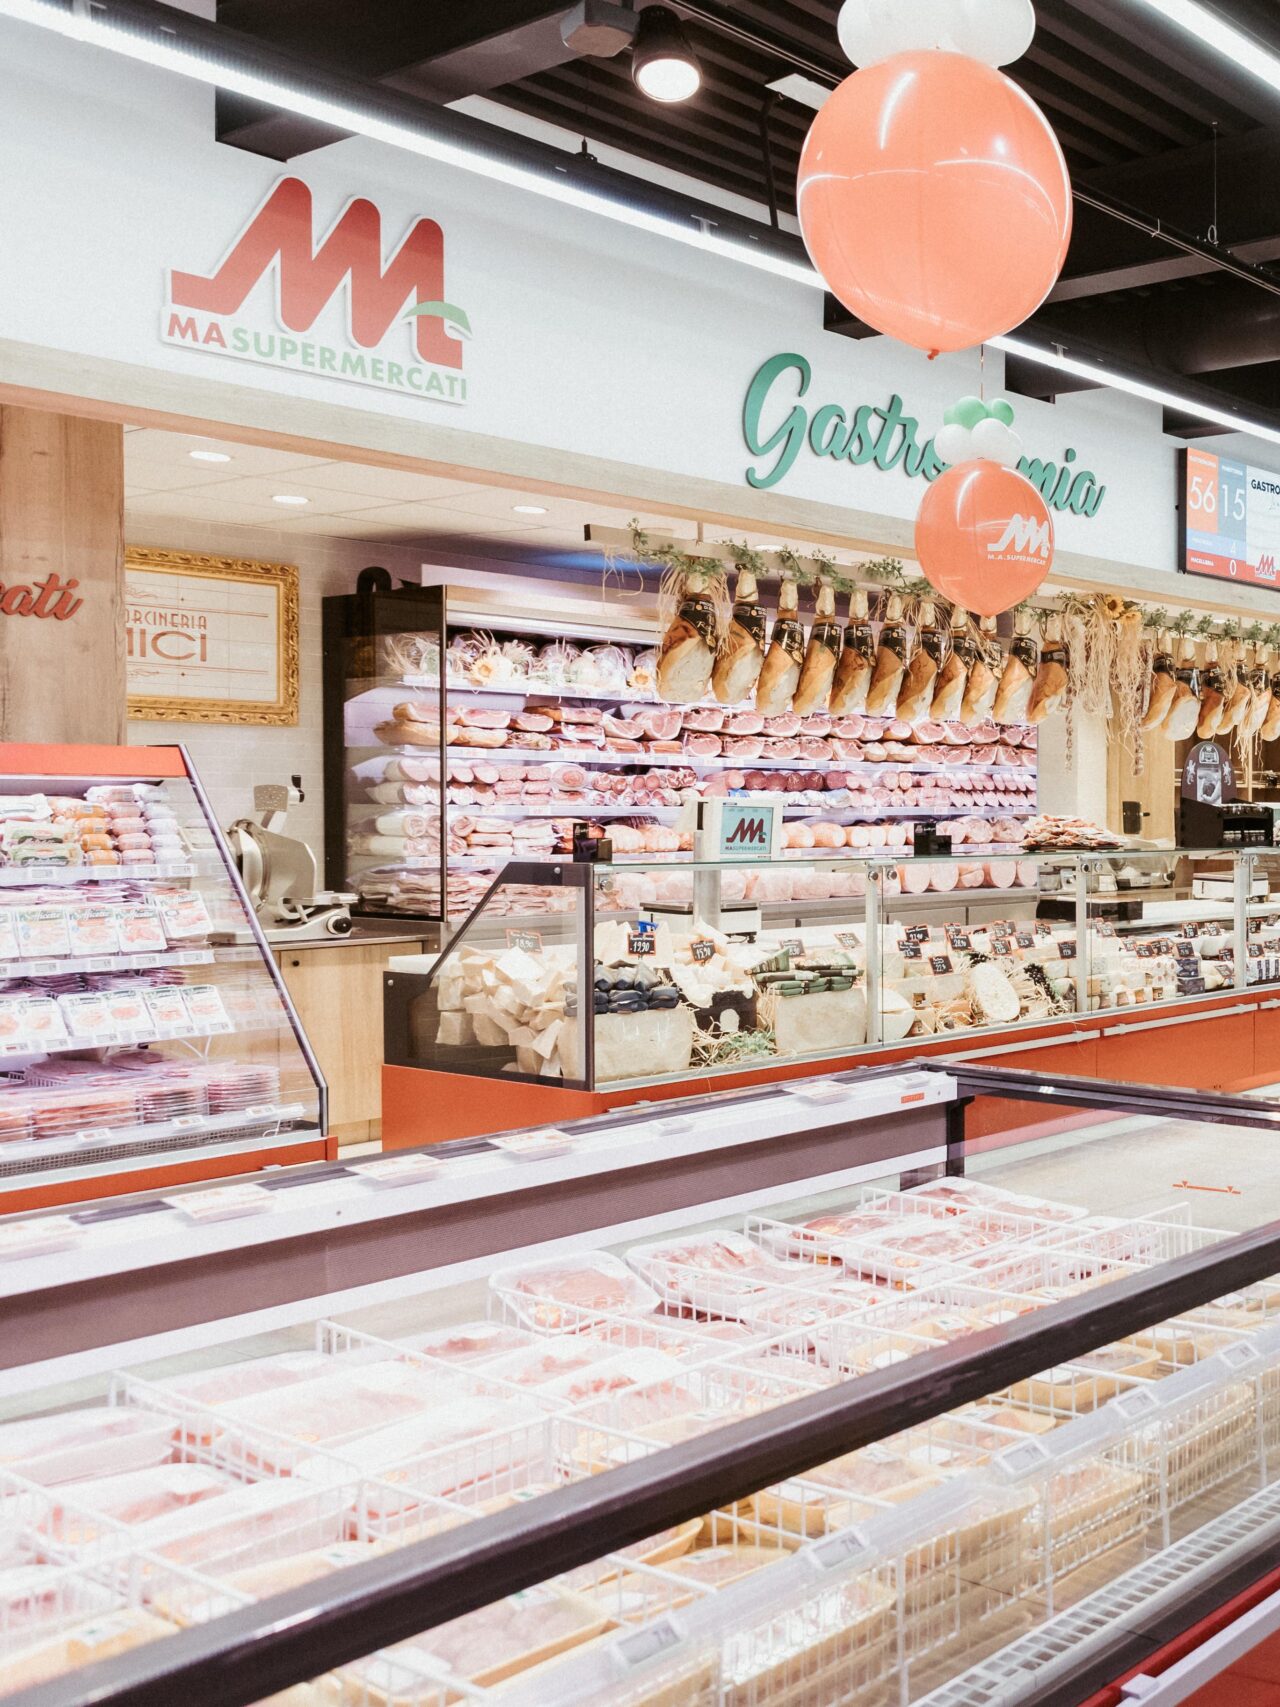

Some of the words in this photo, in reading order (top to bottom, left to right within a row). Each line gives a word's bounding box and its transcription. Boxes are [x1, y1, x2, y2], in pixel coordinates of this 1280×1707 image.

[743, 352, 1107, 518] Gastromia
[1189, 476, 1216, 513] 56
[1222, 484, 1245, 521] 15
[1229, 559, 1237, 576] 0
[0, 573, 84, 620] ati
[125, 610, 208, 630] RCINERIA
